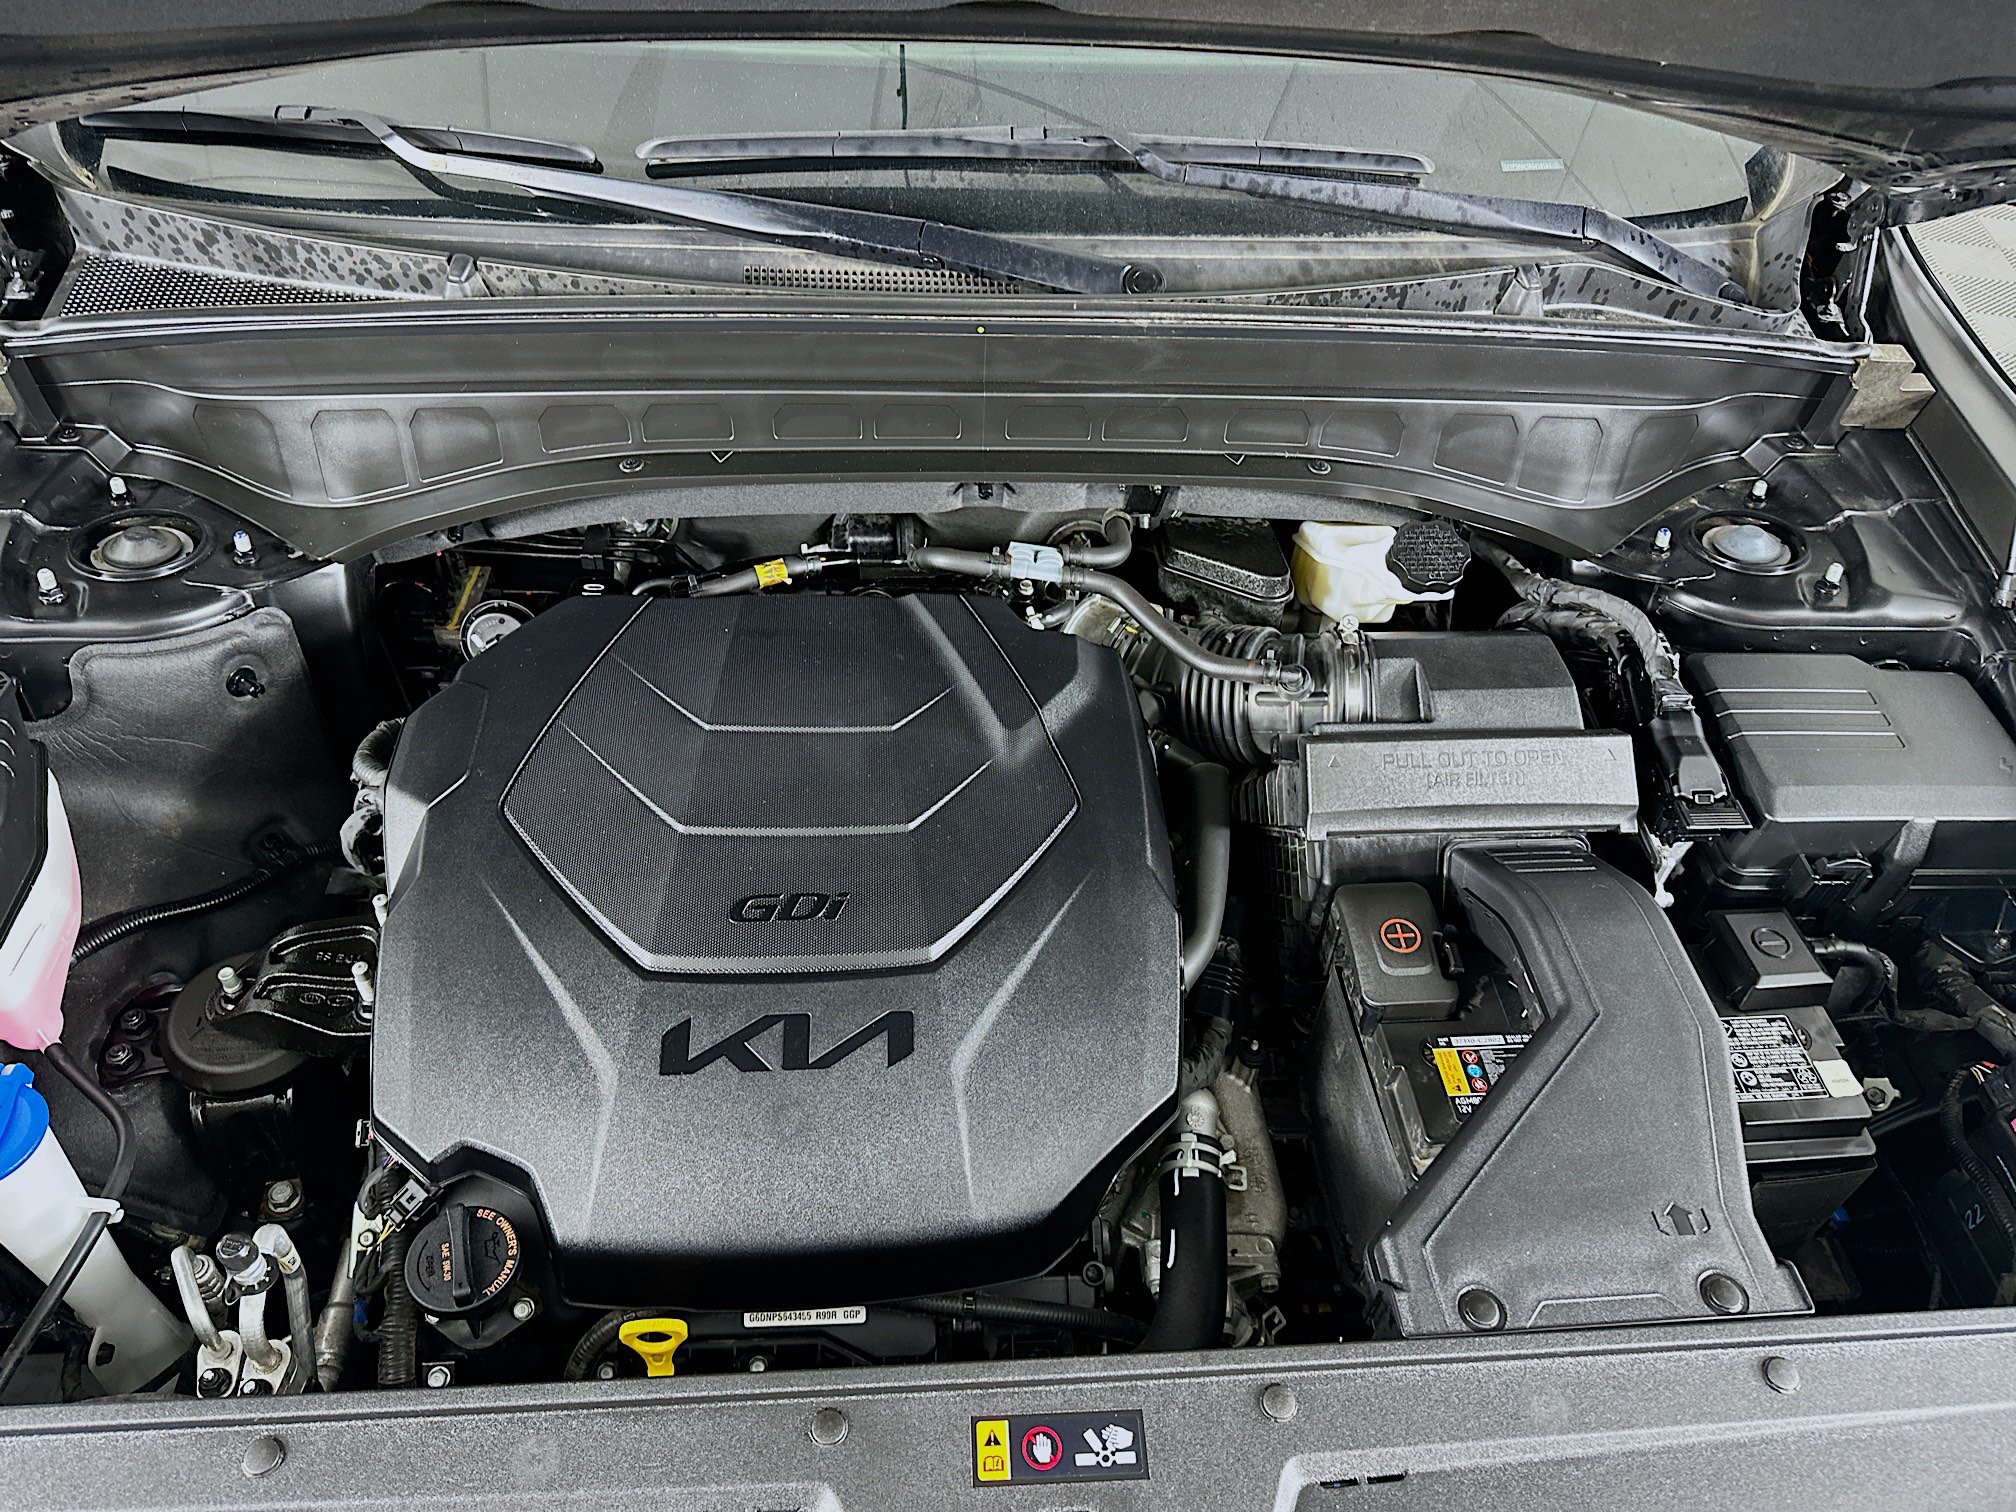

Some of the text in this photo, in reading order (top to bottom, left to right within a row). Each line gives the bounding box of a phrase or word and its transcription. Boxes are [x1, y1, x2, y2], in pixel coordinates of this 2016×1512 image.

[1382, 748, 1566, 770] PULL OUT TO OPEN
[729, 891, 851, 923] GDi
[660, 1010, 915, 1076] KIA
[1457, 1104, 1472, 1114] 12V
[1965, 1204, 1986, 1230] 22
[441, 1242, 451, 1258] SAE
[476, 1208, 518, 1296] SEE OWNER'S MANUAL
[843, 1309, 861, 1319] GGP
